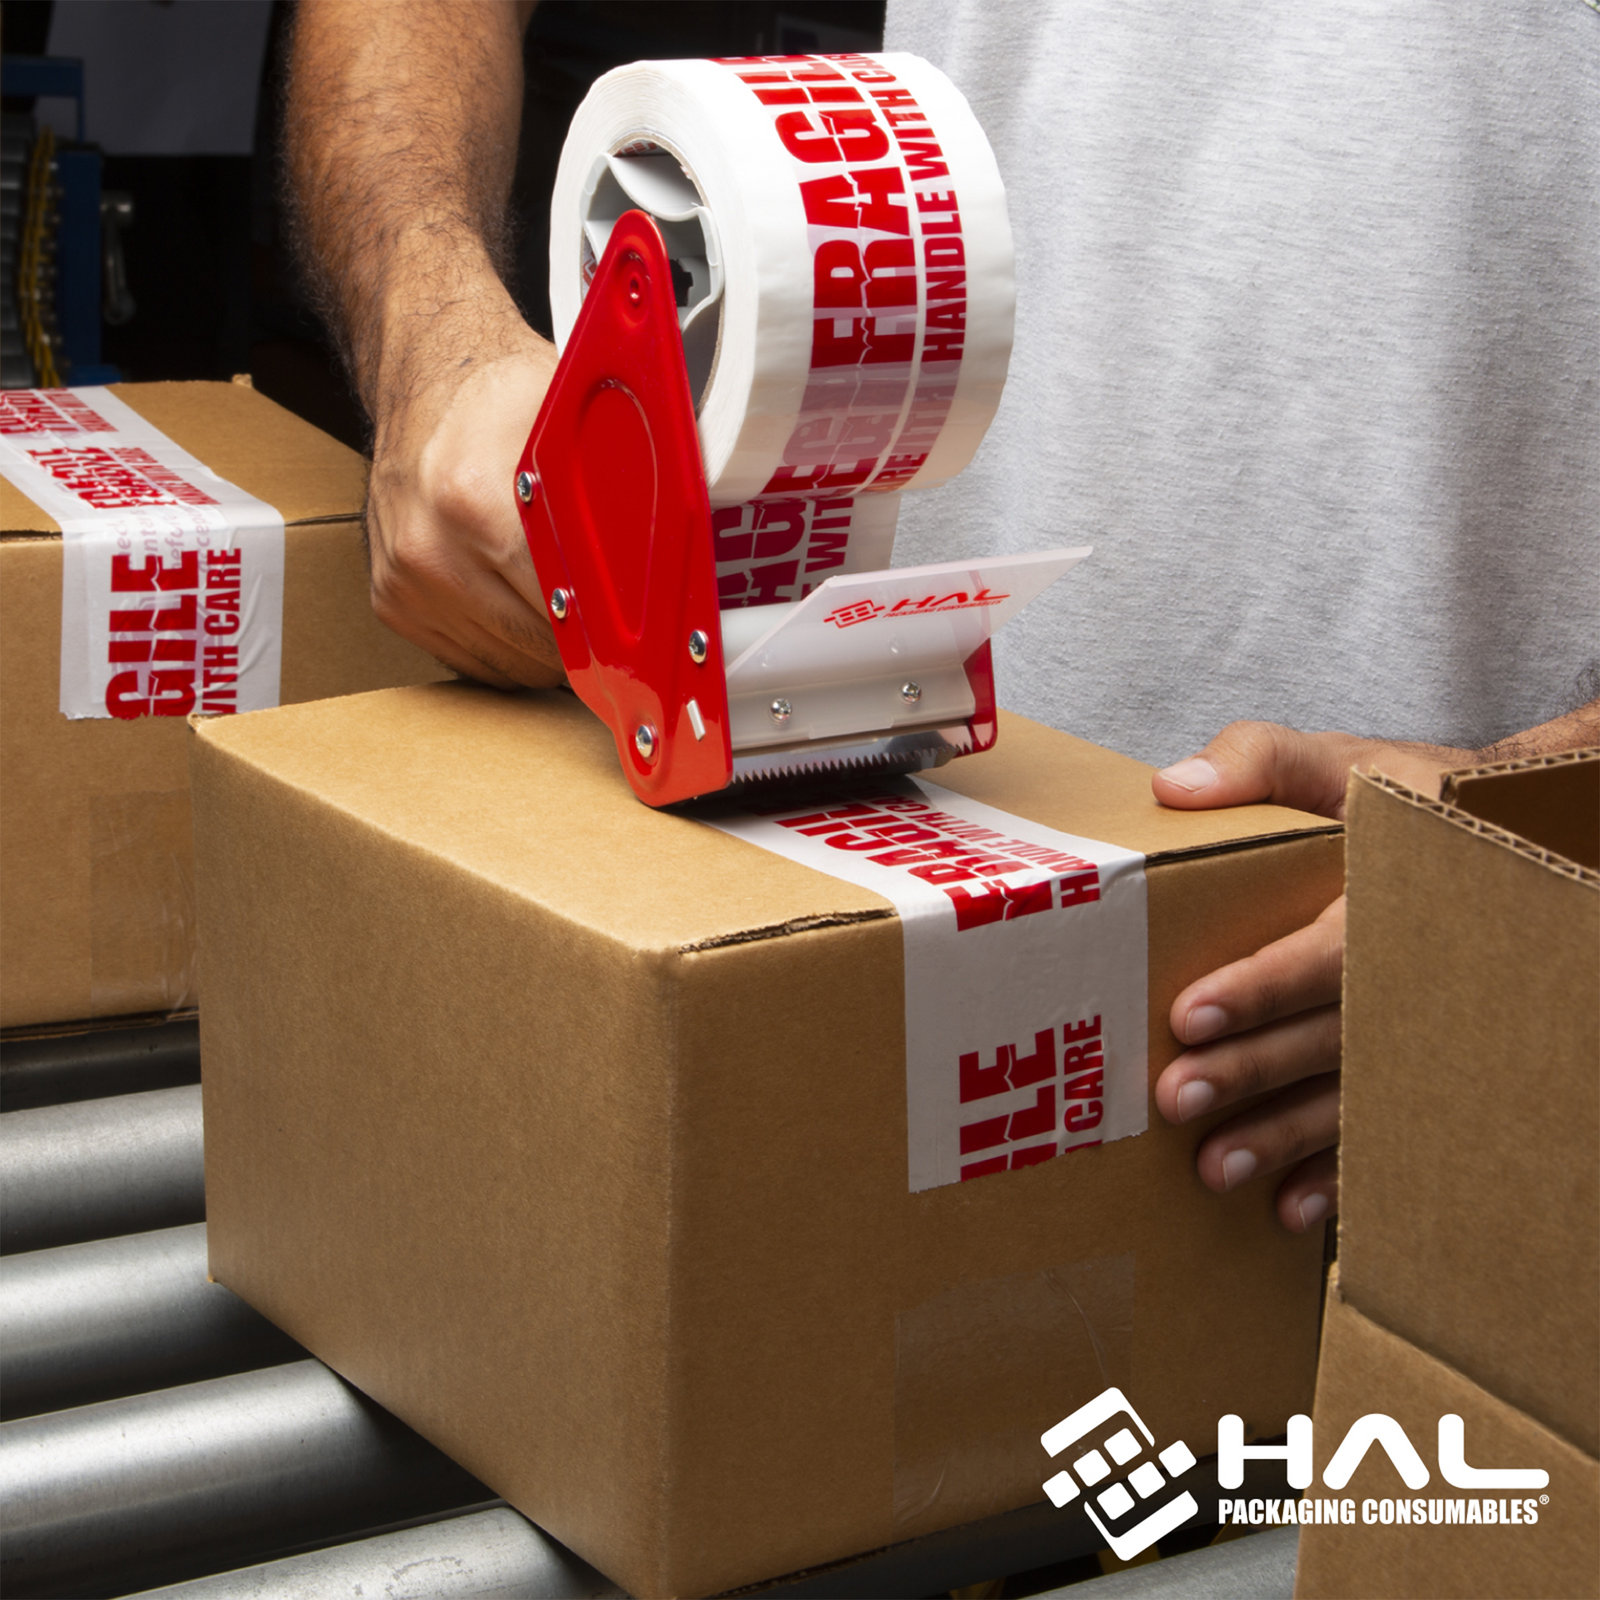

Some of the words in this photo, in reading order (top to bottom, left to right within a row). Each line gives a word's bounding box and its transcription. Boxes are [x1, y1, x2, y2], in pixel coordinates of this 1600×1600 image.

[820, 53, 897, 84] CAR
[868, 88, 951, 182] WITH
[914, 190, 967, 363] HANDLE
[203, 547, 242, 636] CARE
[891, 589, 1011, 612] HAL
[915, 810, 1006, 844] WITH
[978, 838, 1101, 909] HANDLE
[1062, 1013, 1104, 1134] CARE
